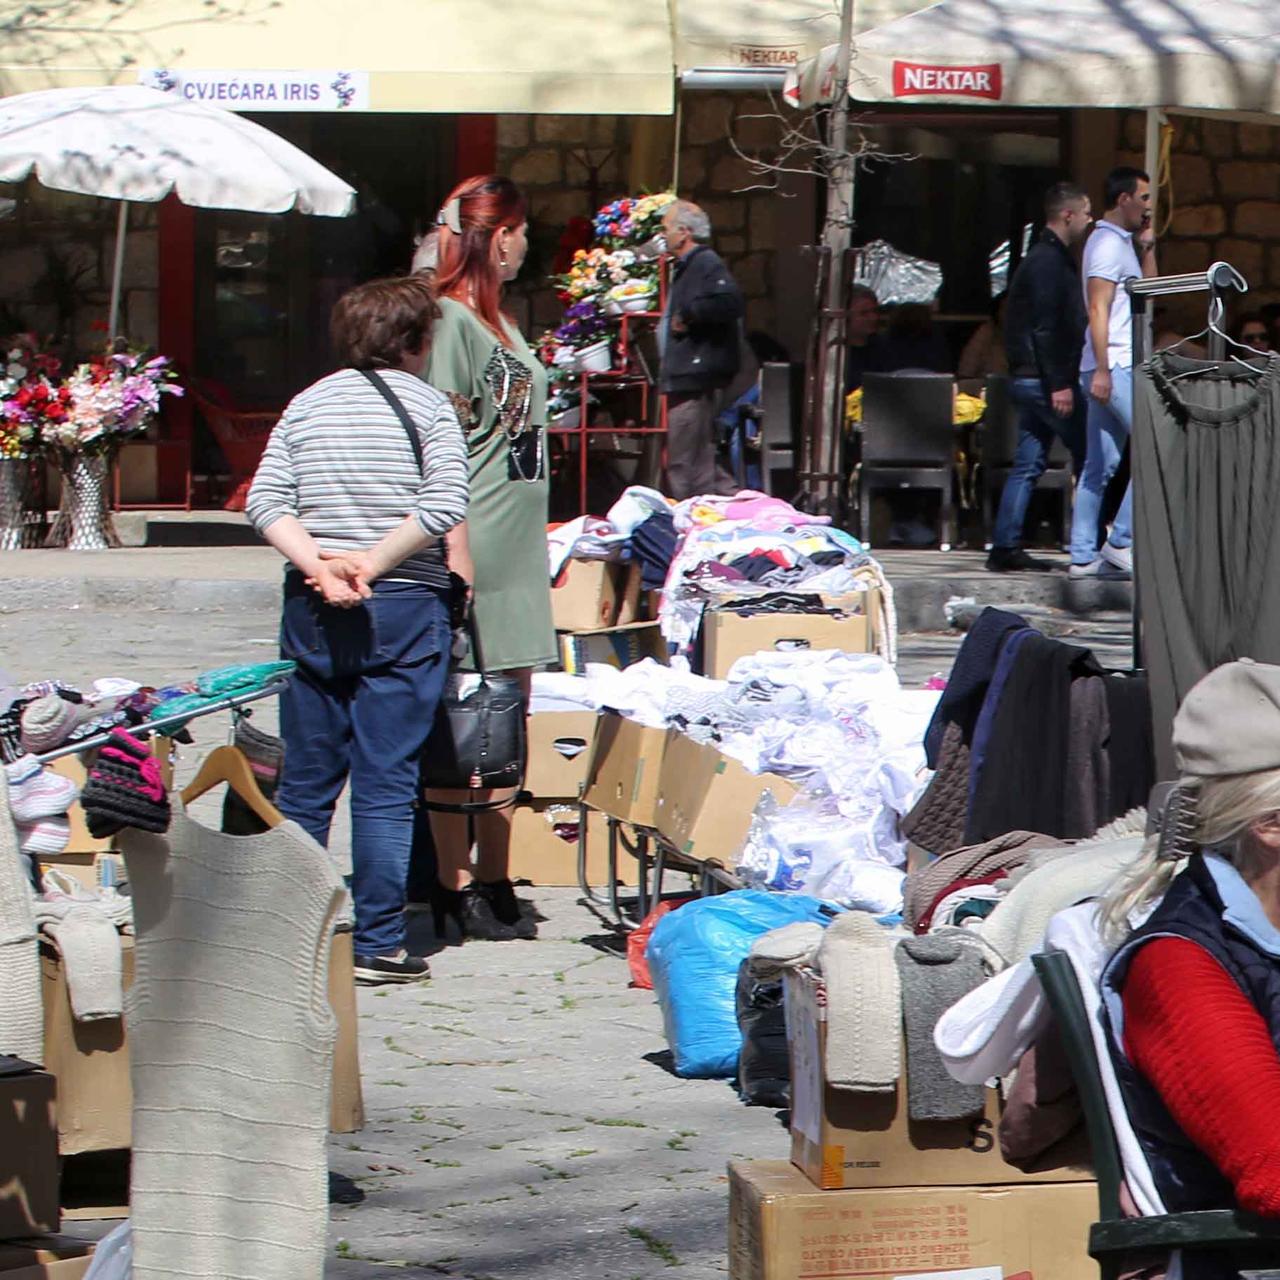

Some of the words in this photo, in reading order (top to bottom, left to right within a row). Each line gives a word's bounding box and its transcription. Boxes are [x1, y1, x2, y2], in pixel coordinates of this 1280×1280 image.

[740, 50, 798, 64] NEKTAR
[183, 79, 279, 101] CVJEĆARA
[283, 83, 321, 101] IRIS
[903, 67, 992, 92] NEKTAR
